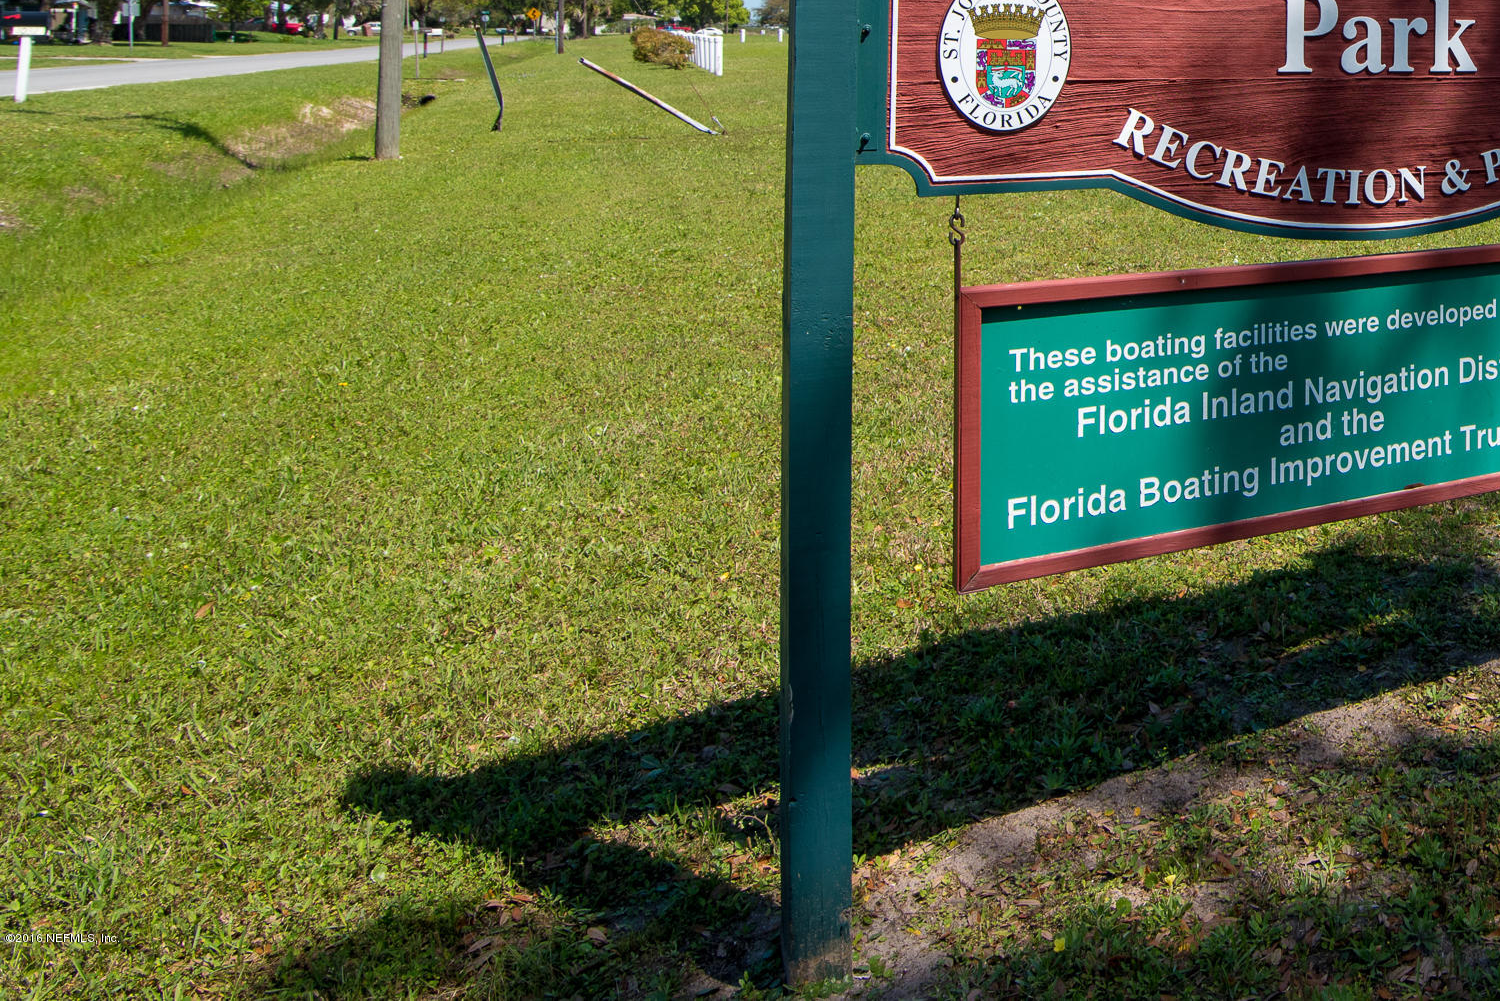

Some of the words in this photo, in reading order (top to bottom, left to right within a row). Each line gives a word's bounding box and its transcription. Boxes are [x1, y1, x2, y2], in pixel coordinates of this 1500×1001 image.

[943, 29, 960, 60] ST.
[958, 93, 1052, 128] FLORIDA
[1112, 107, 1427, 204] RECREATION
[1440, 159, 1472, 195] &
[1009, 346, 1096, 372] These
[1106, 333, 1206, 363] boating
[1214, 321, 1317, 350] facilities
[1325, 315, 1380, 337] were
[1386, 298, 1497, 331] developed
[1009, 378, 1054, 404] the
[1063, 363, 1209, 398] assistance
[1217, 354, 1242, 379] of
[1249, 351, 1288, 374] the
[1077, 396, 1190, 438] Florida
[1202, 381, 1293, 421] Inland
[1304, 363, 1449, 406] Navigation
[1280, 411, 1332, 446] and
[1341, 408, 1385, 436] the
[1007, 484, 1127, 530] Florida
[1139, 465, 1259, 509] Boating
[1270, 430, 1452, 486] Improvement
